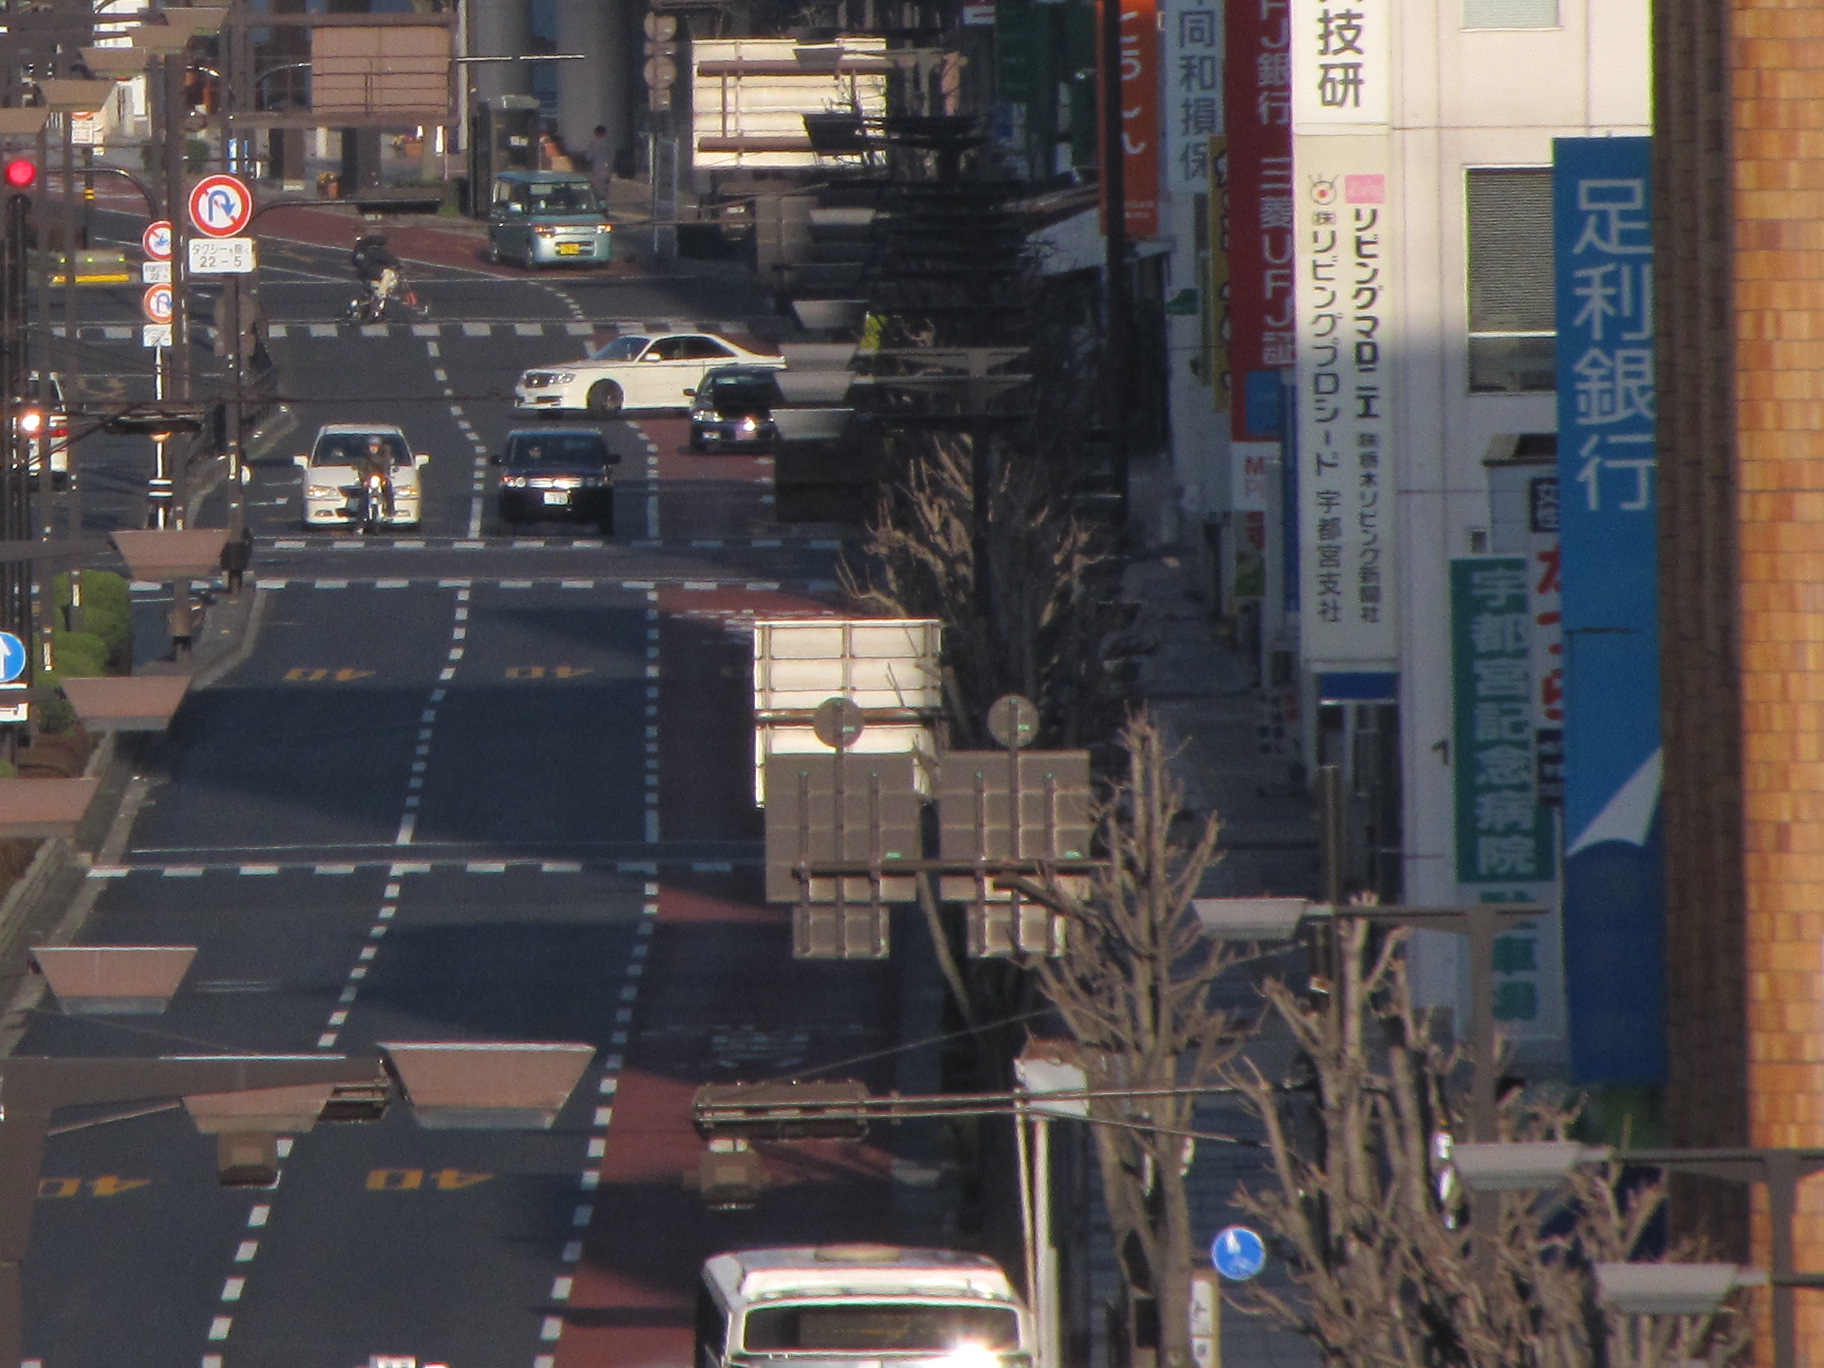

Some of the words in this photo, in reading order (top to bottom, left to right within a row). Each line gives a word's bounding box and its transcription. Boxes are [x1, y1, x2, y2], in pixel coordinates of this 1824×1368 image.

[1351, 207, 1383, 420] リビングマロニエ
[1571, 178, 1657, 511] 足利銀行
